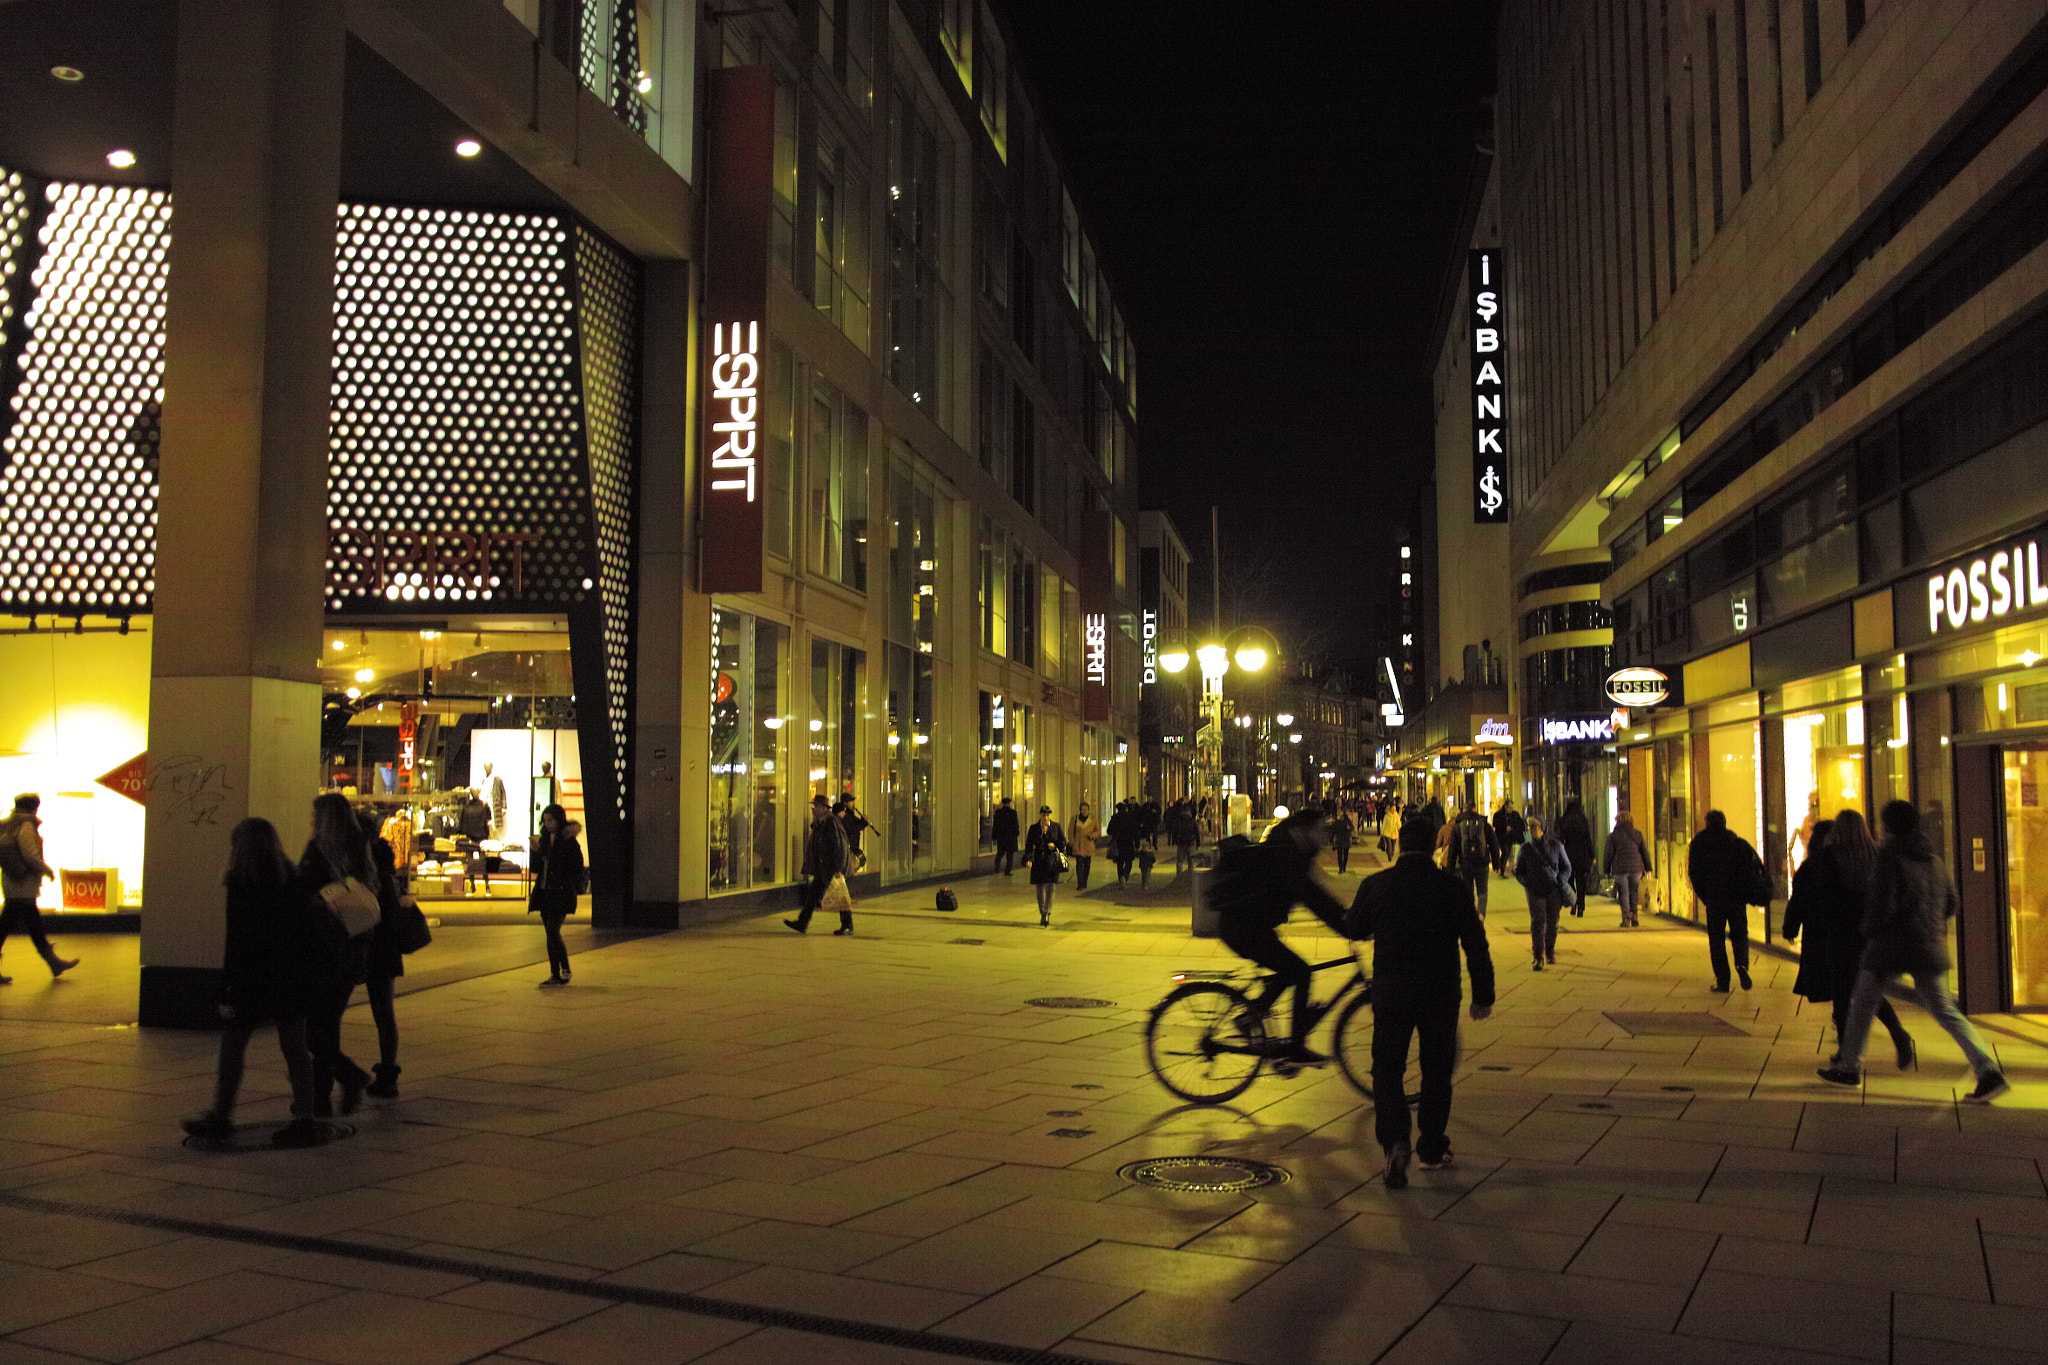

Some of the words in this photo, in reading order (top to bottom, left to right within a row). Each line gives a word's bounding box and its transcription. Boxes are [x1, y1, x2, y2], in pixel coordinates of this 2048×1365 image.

[712, 320, 758, 502] ESPRIT
[1928, 541, 2048, 634] FOSSIL
[1086, 613, 1105, 687] ESPRIT
[1613, 680, 1666, 693] FOSSIL
[1480, 718, 1509, 736] dm
[65, 882, 103, 897] NOW
